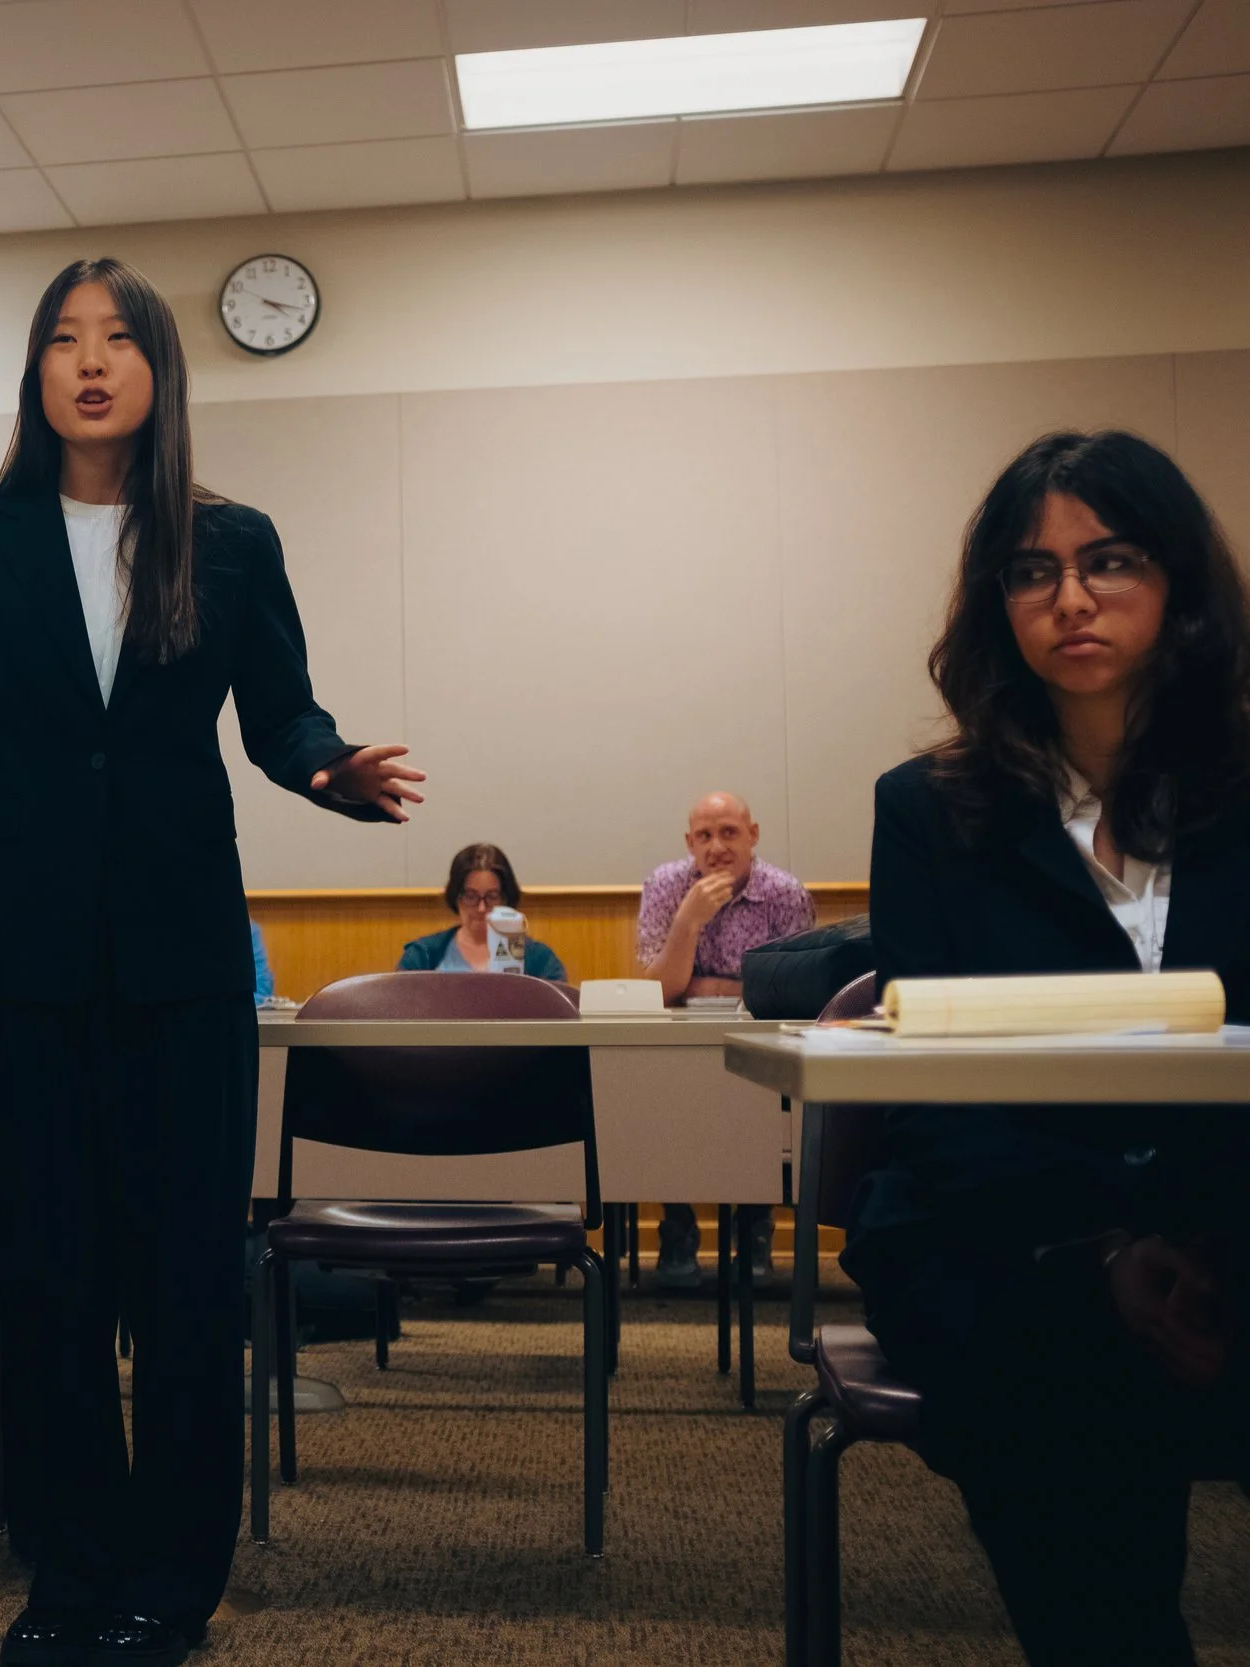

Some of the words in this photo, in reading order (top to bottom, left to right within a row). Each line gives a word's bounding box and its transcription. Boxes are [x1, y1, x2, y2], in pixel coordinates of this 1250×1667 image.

[262, 260, 277, 273] 12
[246, 267, 257, 280] 11
[231, 281, 244, 294] 10
[297, 277, 306, 290] 2
[227, 299, 236, 311] 9
[304, 294, 311, 307] 3
[233, 316, 242, 328] 8
[297, 313, 306, 325] 4
[248, 330, 256, 344] 7
[265, 334, 275, 346] 6
[285, 328, 293, 341] 5
